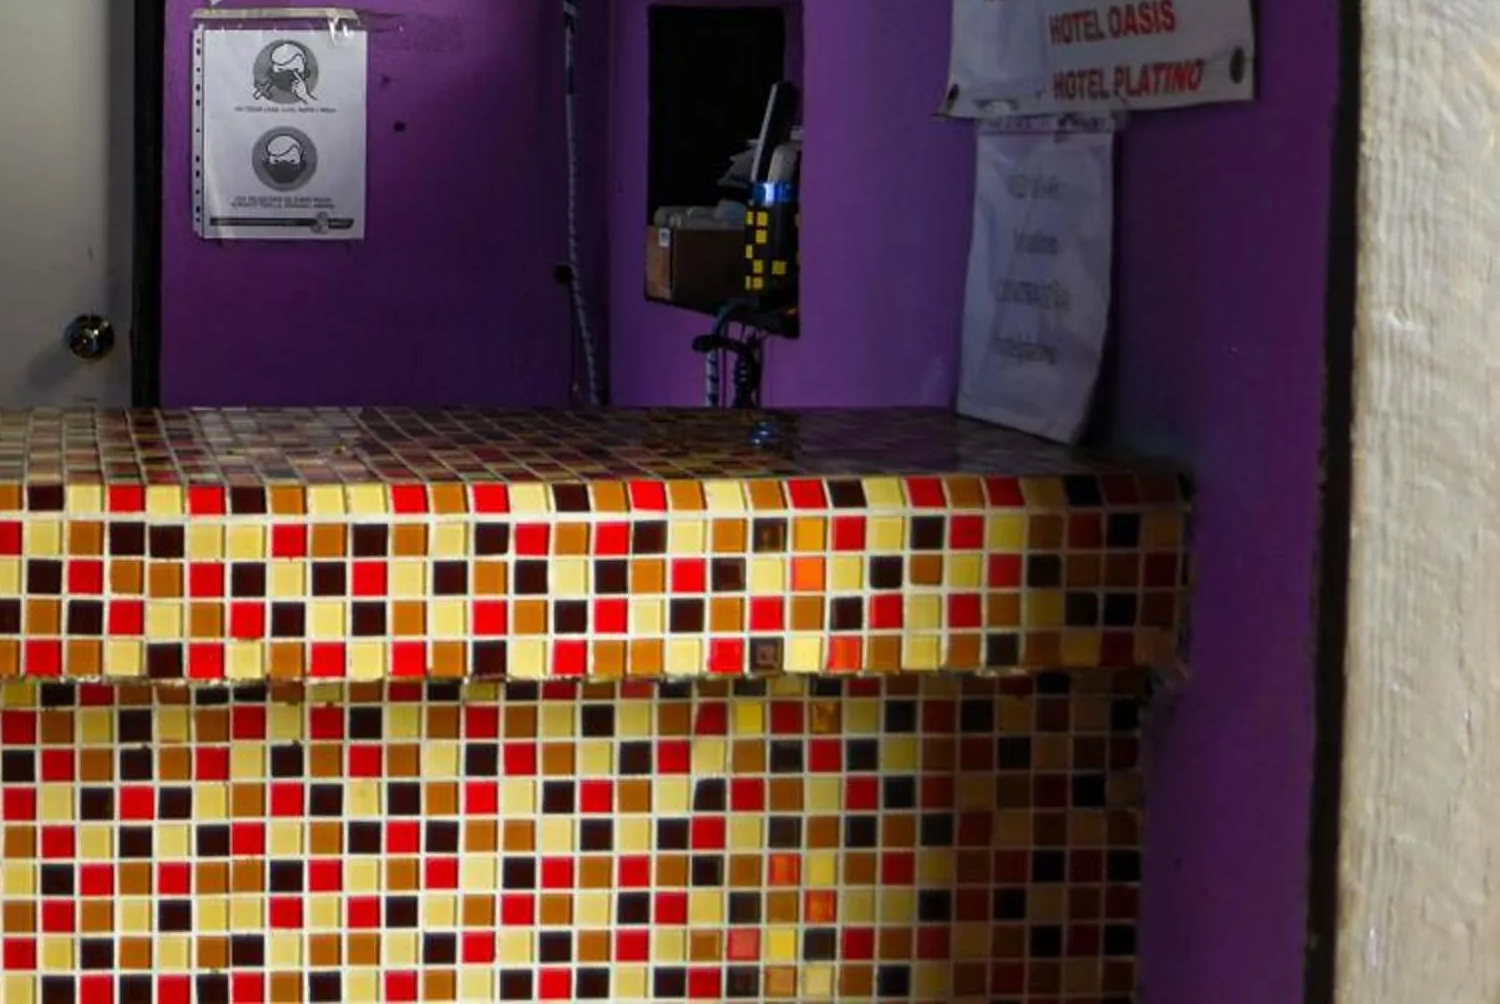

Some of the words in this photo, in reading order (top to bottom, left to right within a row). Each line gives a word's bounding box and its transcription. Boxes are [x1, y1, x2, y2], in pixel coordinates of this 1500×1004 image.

[1049, 9, 1106, 45] HOTEL
[1053, 68, 1110, 101] HOTEL
[1113, 57, 1206, 98] PLATINO
